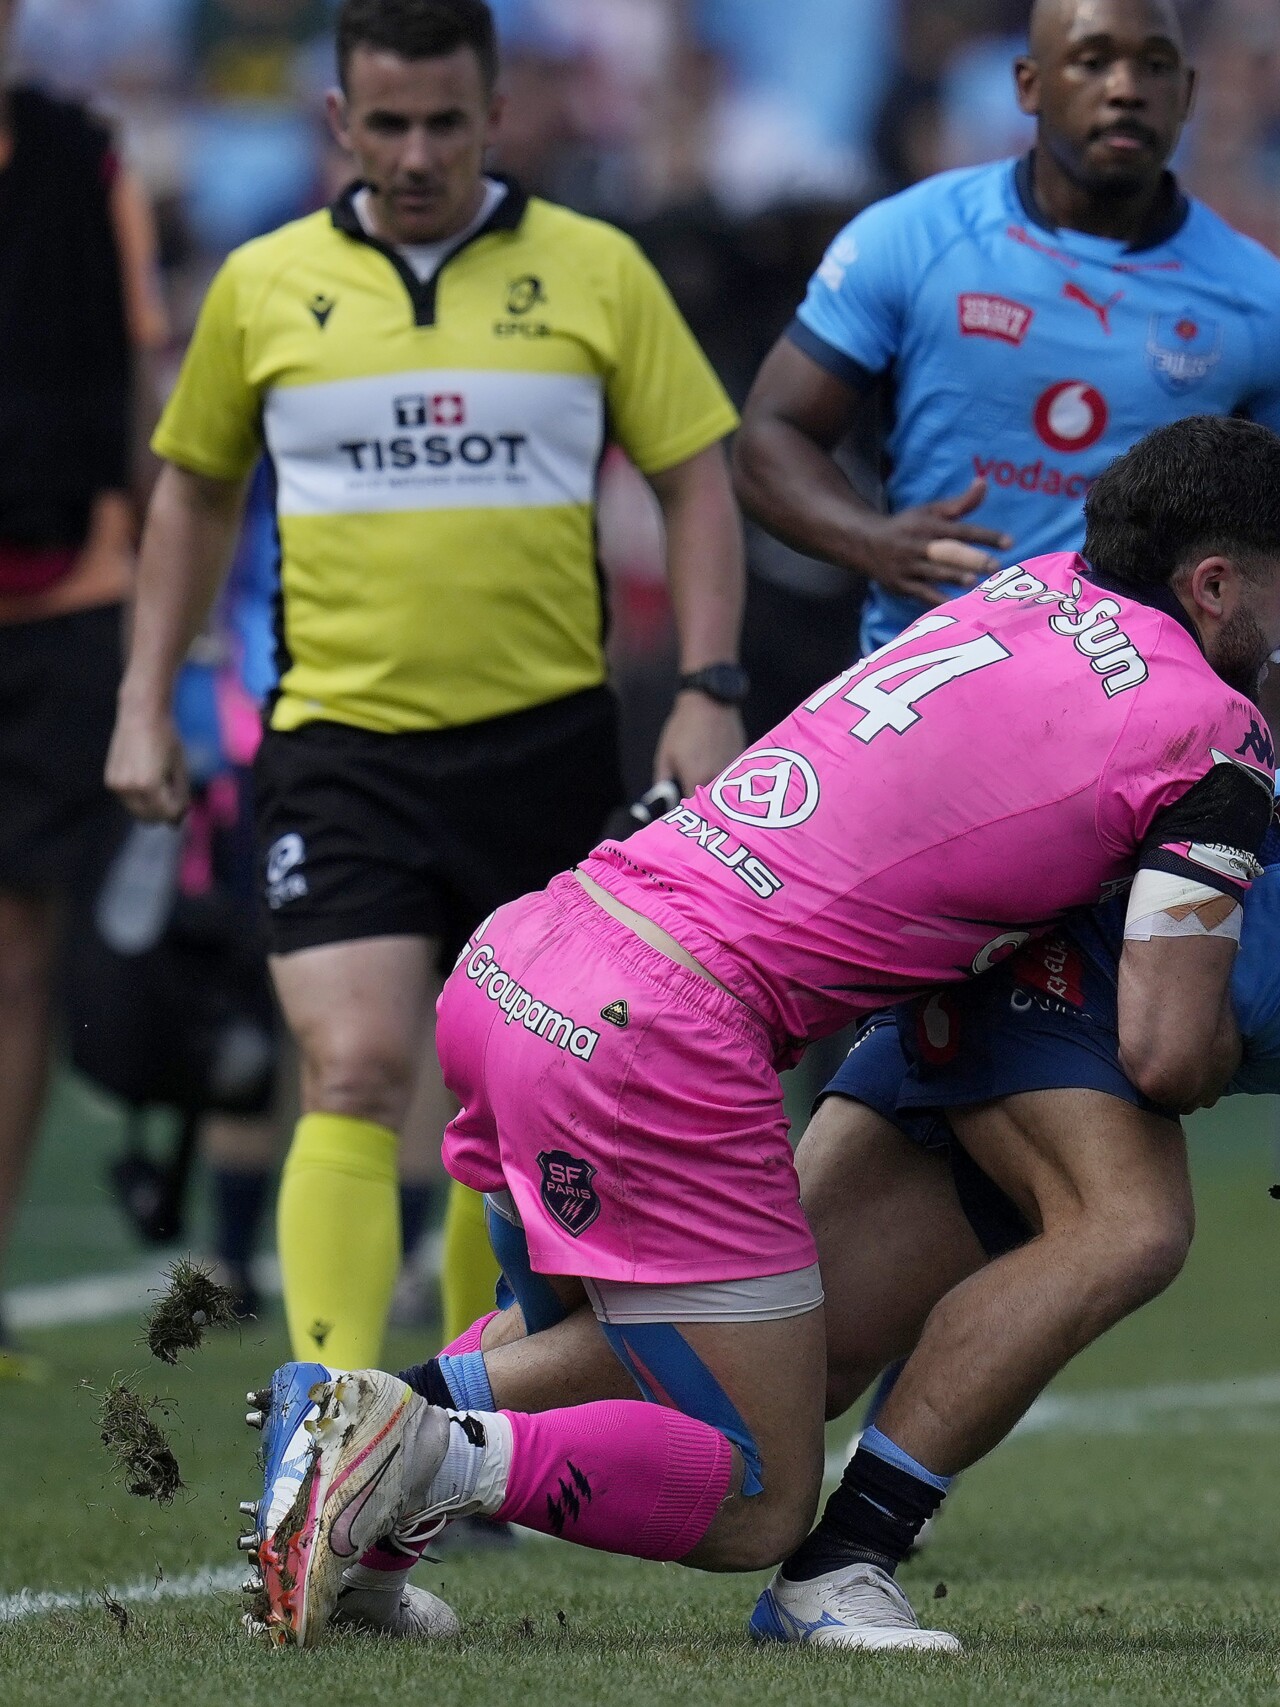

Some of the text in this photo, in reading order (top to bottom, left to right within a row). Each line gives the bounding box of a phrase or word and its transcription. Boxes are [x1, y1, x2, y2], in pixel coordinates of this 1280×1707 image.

[338, 431, 528, 474] TISSOT
[972, 452, 1098, 501] vodac
[802, 613, 1015, 746] 14
[465, 943, 601, 1063] Groupama
[546, 1181, 592, 1200] PARIS
[548, 1162, 583, 1185] SF
